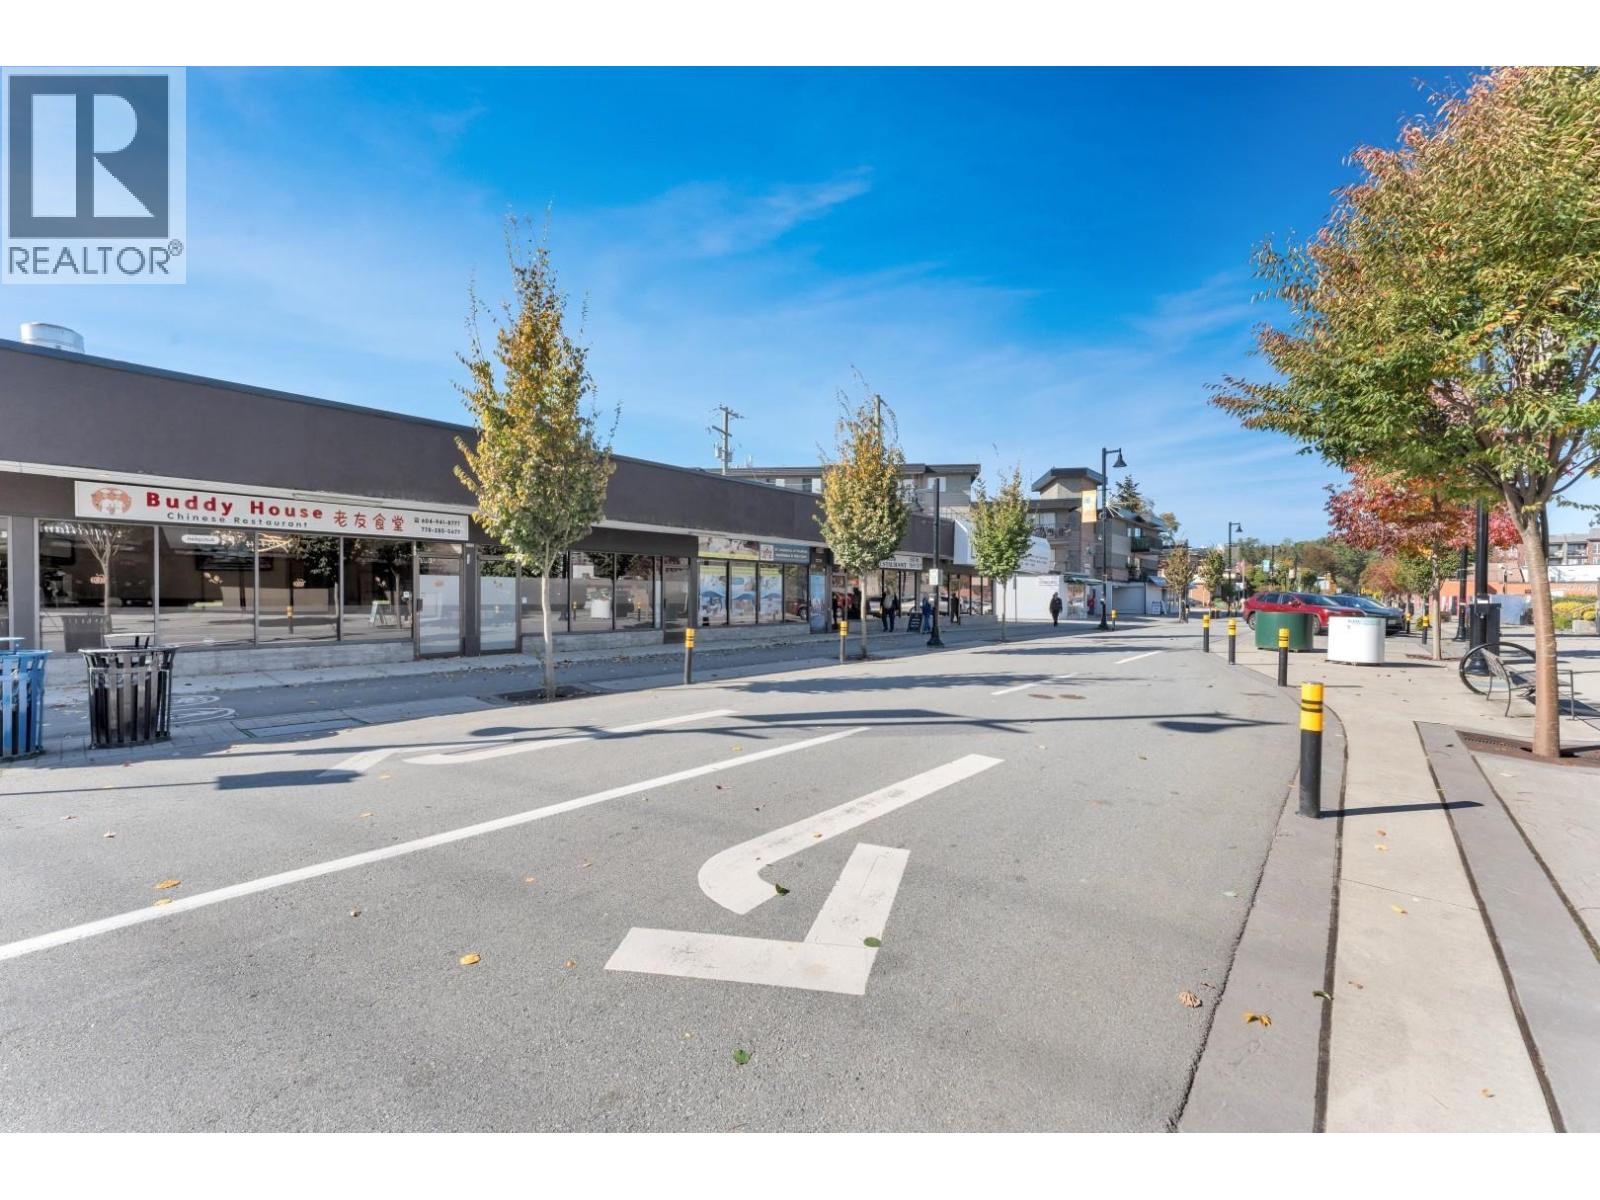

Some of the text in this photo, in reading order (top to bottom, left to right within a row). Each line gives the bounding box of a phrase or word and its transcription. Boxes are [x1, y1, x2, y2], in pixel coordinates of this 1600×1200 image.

[146, 491, 323, 520] Buddy House
[167, 511, 308, 529] Chinese Restaurant
[333, 508, 405, 532] 老友食堂
